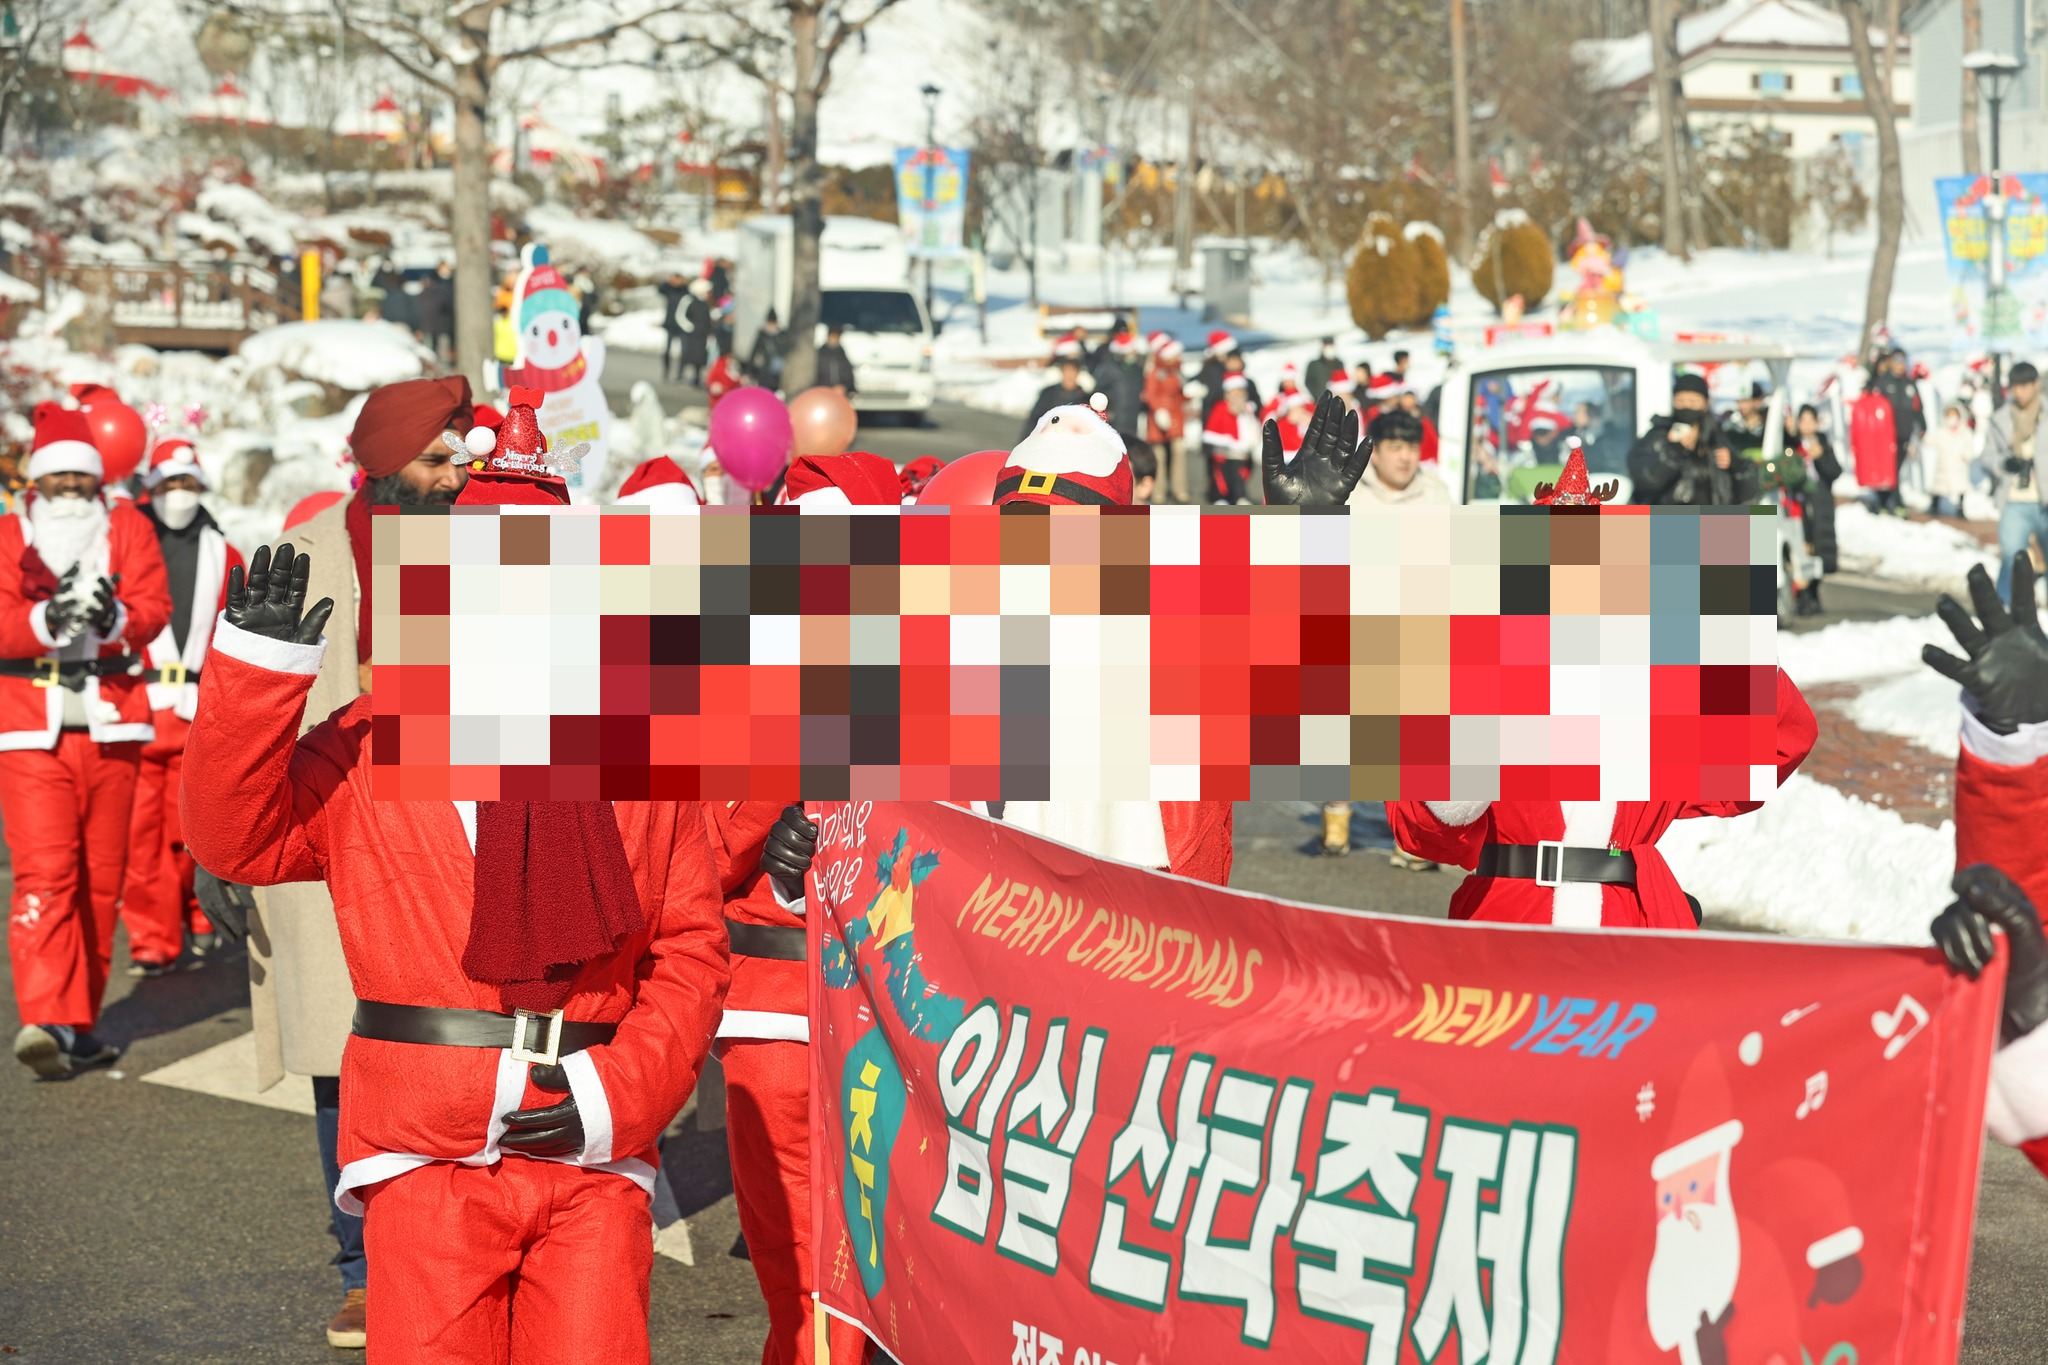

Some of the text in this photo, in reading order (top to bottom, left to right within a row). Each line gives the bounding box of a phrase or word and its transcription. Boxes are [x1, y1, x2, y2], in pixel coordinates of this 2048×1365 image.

[492, 457, 547, 473] Christmas
[505, 448, 538, 464] Merry
[957, 872, 1657, 1060] MERRY CHRISTMAS HAPPY NEW YEAR
[930, 997, 1579, 1365] 임실 산타축제
